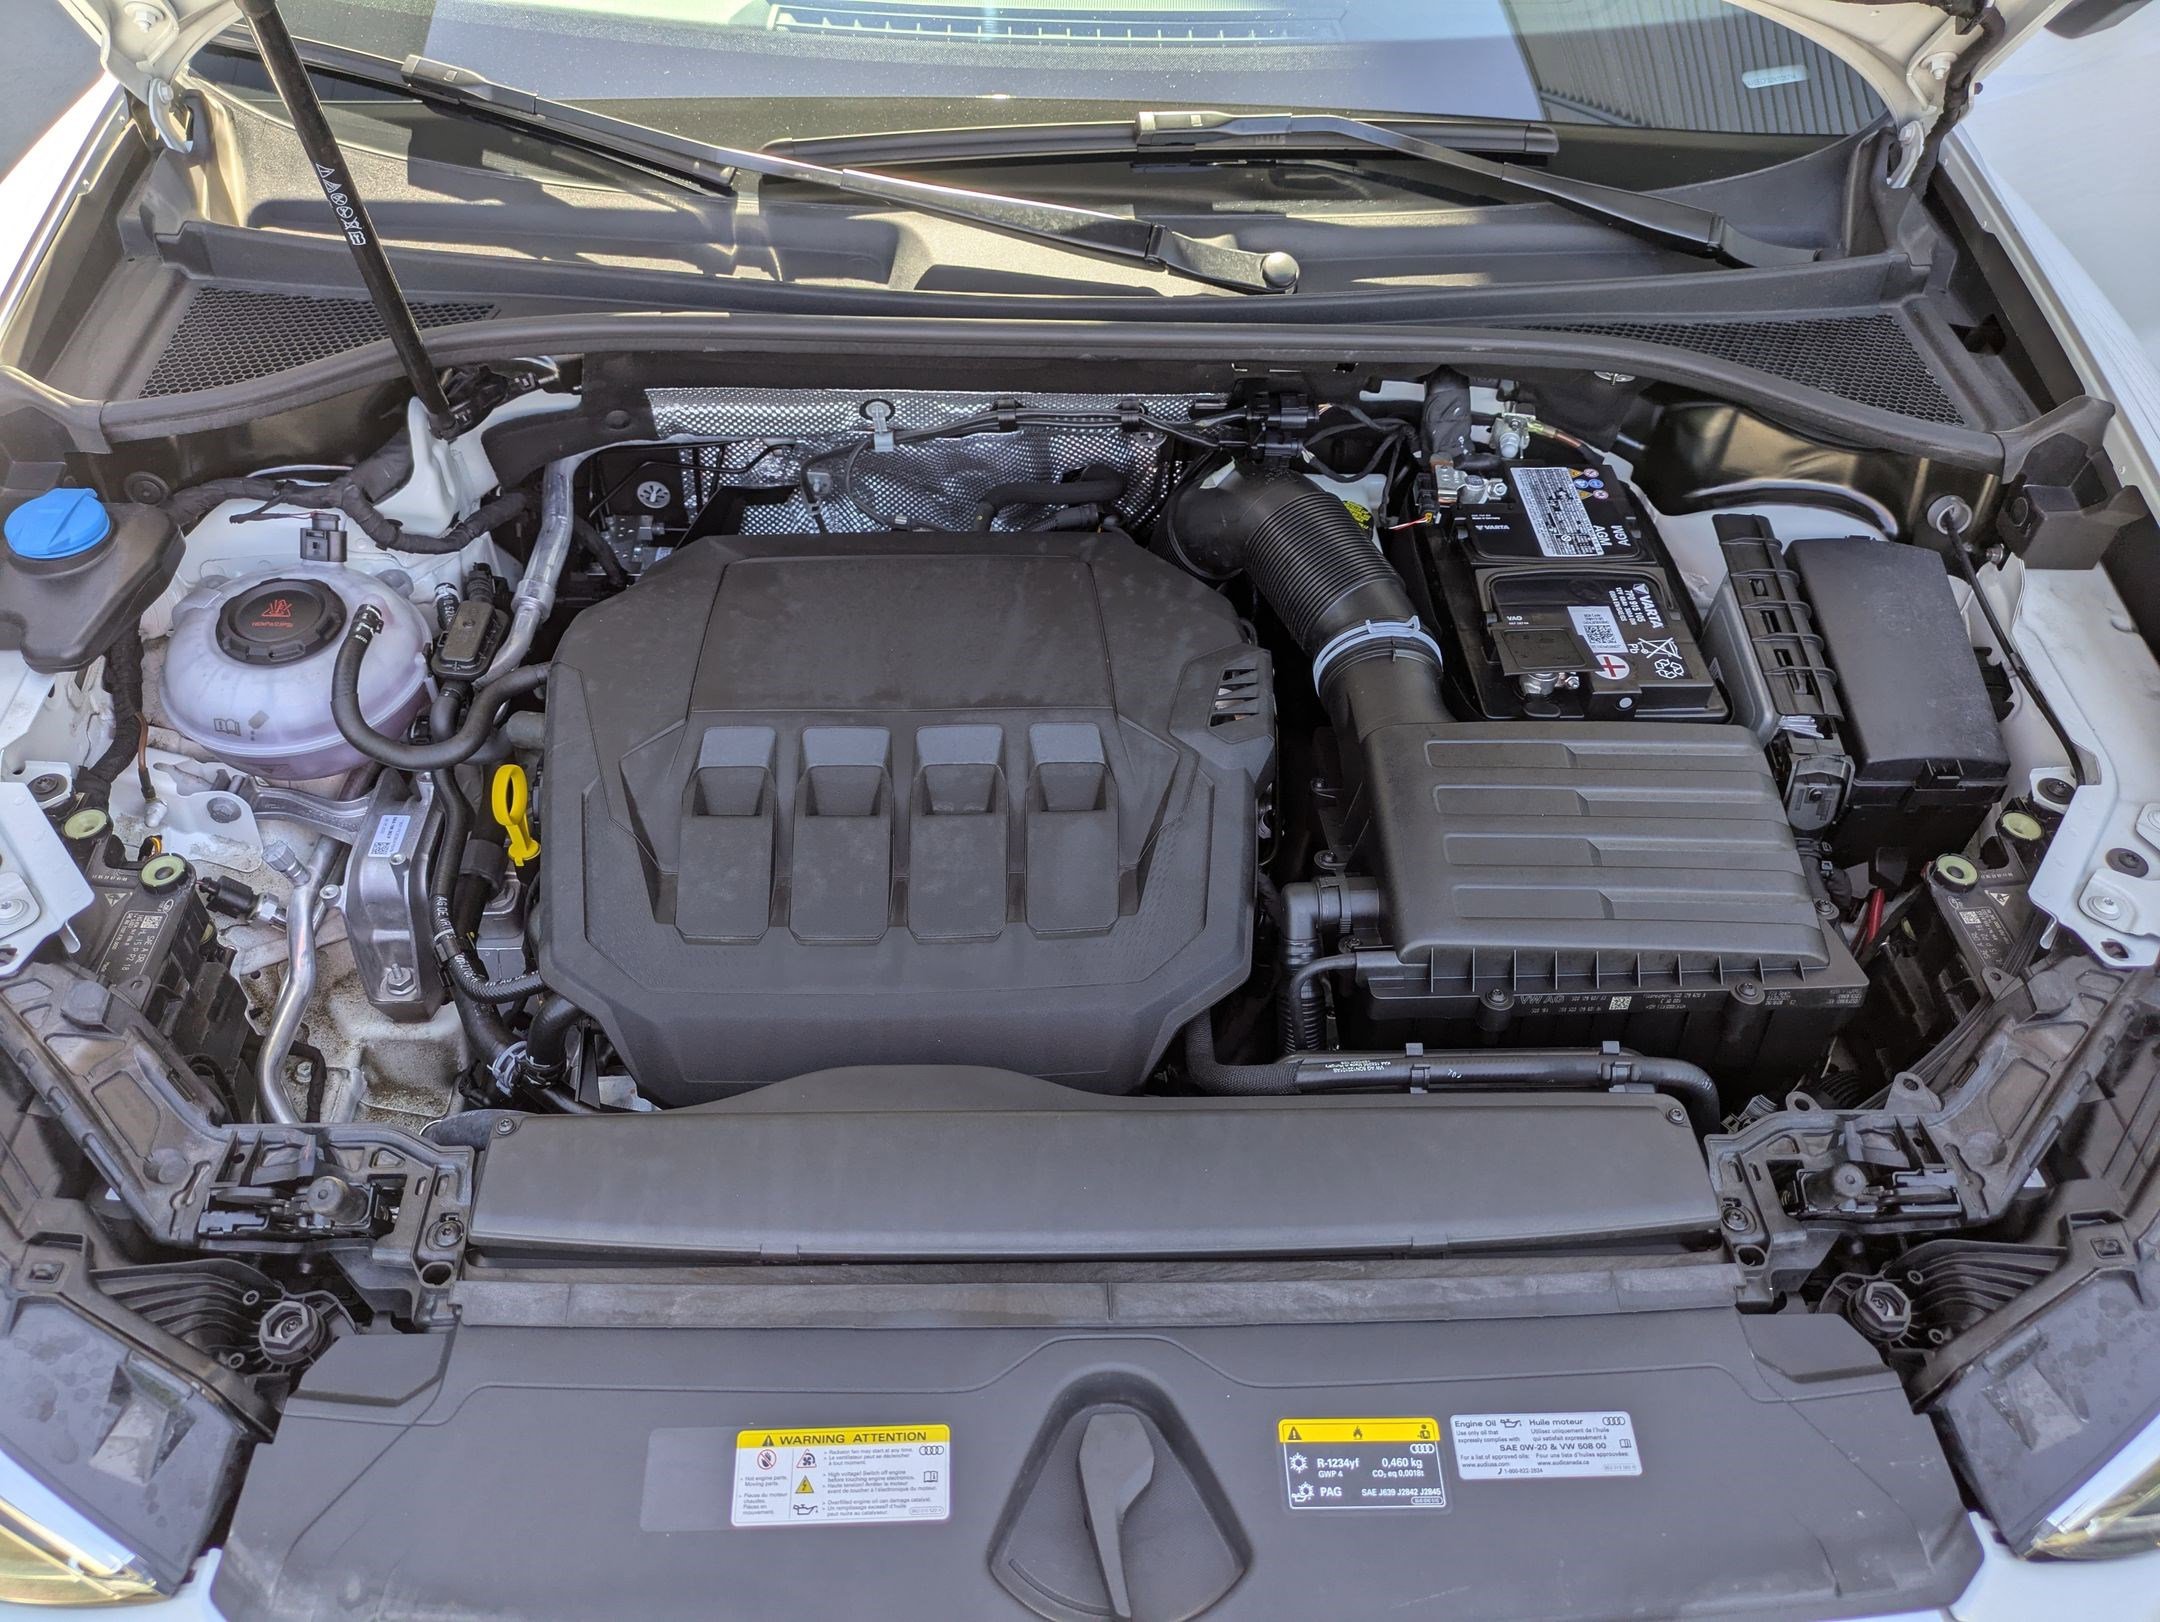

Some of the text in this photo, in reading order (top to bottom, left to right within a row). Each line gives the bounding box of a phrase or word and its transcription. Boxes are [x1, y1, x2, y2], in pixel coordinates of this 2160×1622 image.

[1593, 525, 1612, 546] AGM
[1610, 525, 1631, 546] AGM
[1640, 595, 1664, 628] VARTA
[1627, 644, 1639, 654] Pb
[1520, 996, 1542, 1004] VW
[1544, 995, 1564, 1003] AG
[780, 1432, 927, 1445] WARNING ATTENTION
[1317, 1458, 1359, 1470] R-1234yf
[1382, 1458, 1422, 1469] 0,460 kg
[1320, 1487, 1342, 1497] PAG
